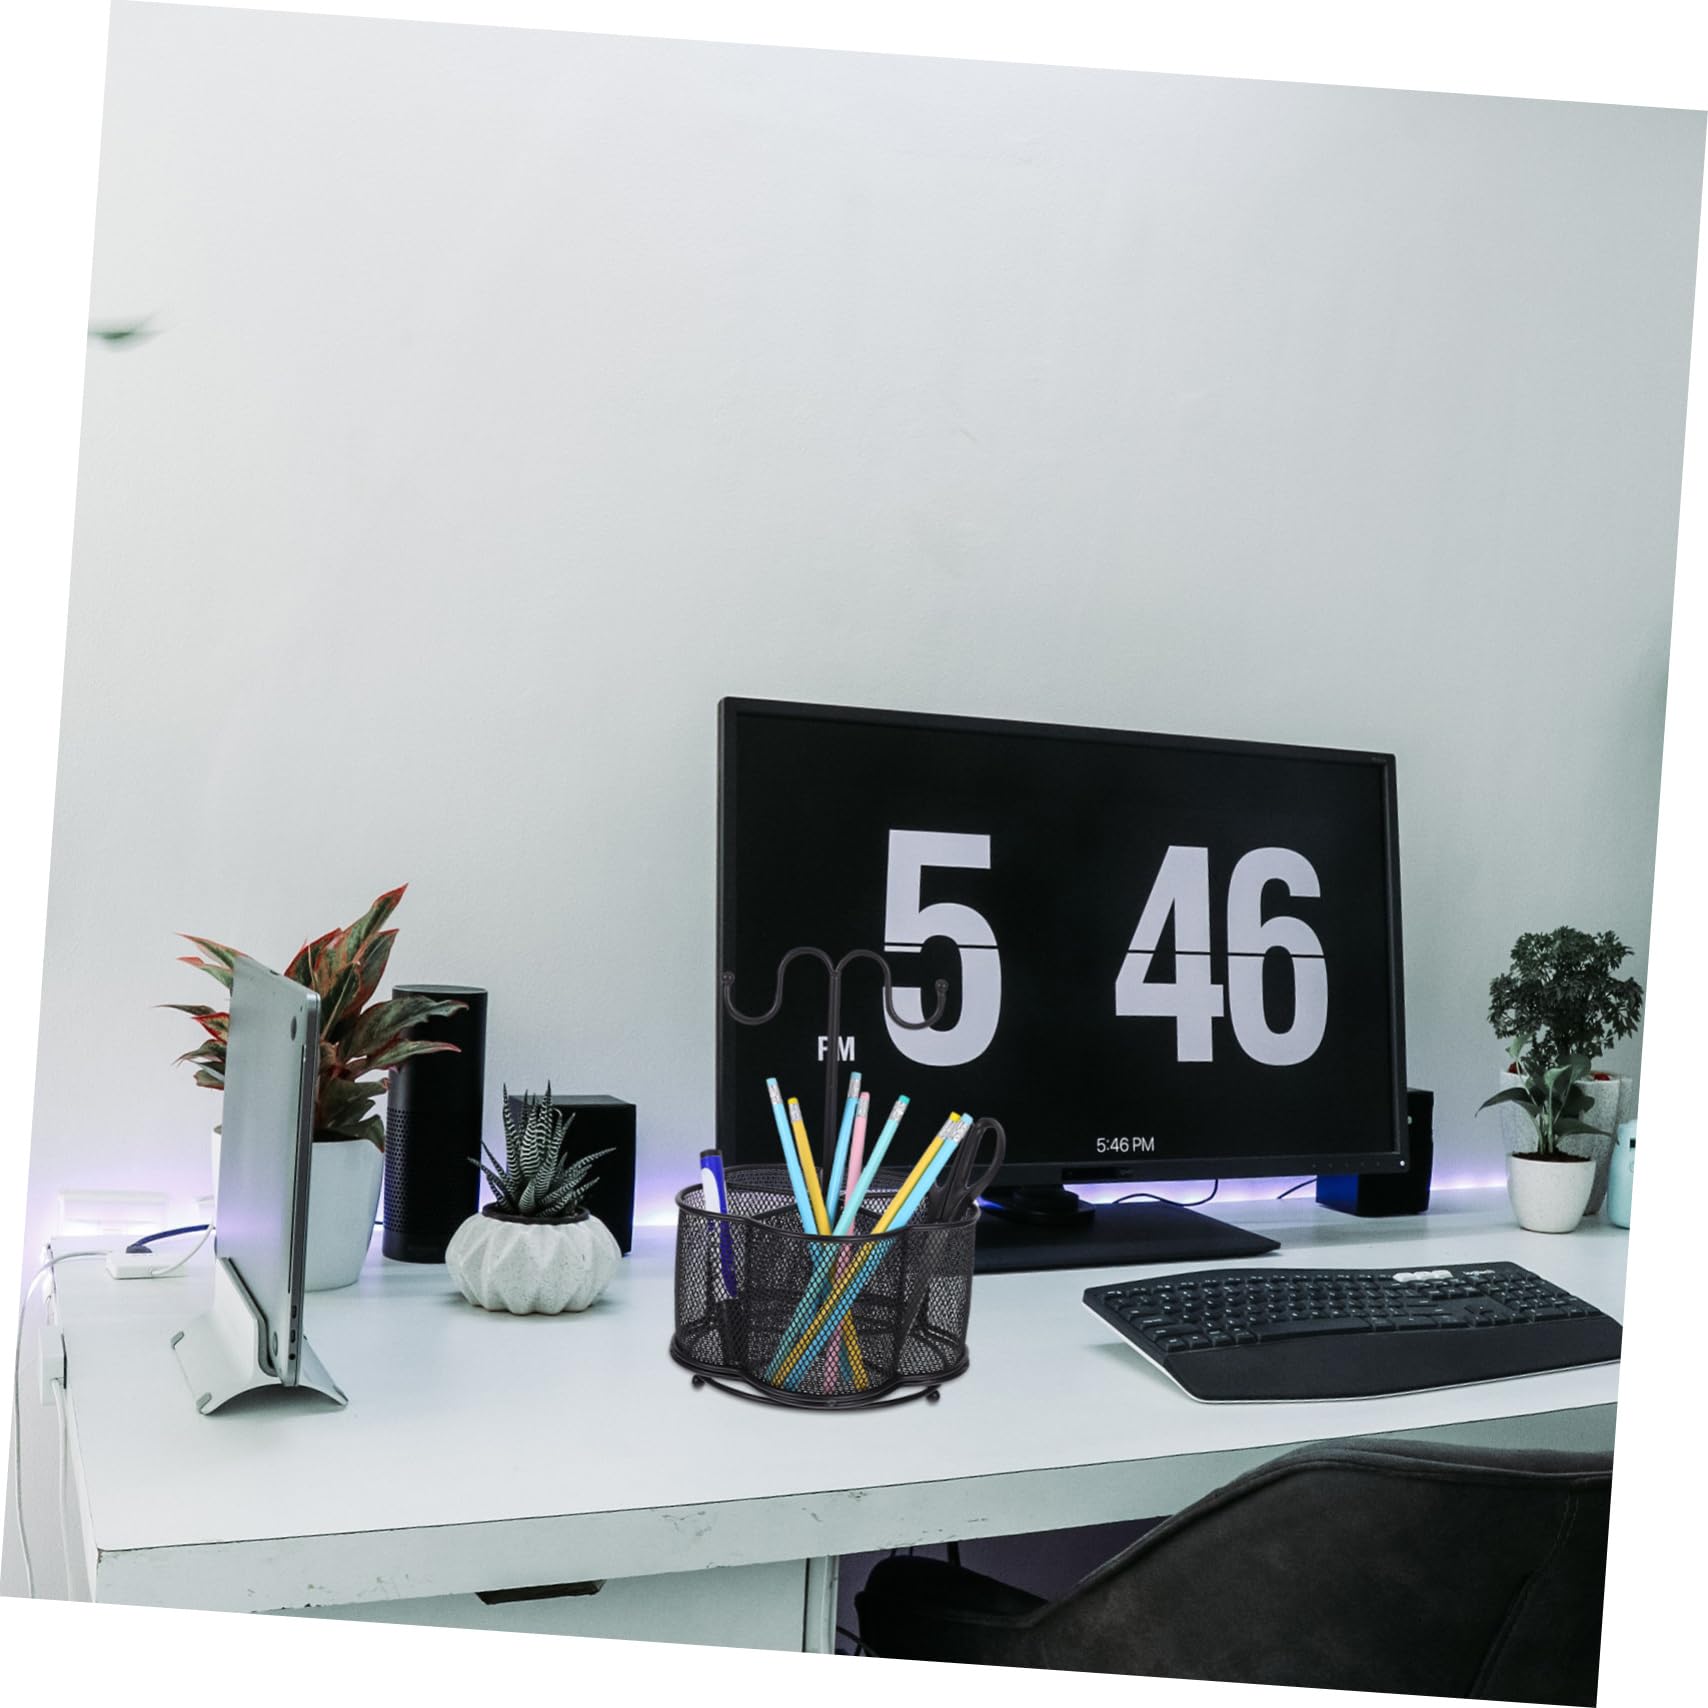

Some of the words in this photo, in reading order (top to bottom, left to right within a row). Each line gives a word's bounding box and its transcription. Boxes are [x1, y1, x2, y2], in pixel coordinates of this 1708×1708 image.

[882, 829, 1002, 1067] 5
[1115, 845, 1329, 1066] 46
[1096, 1137, 1130, 1153] 5:46
[1132, 1136, 1155, 1152] PM
